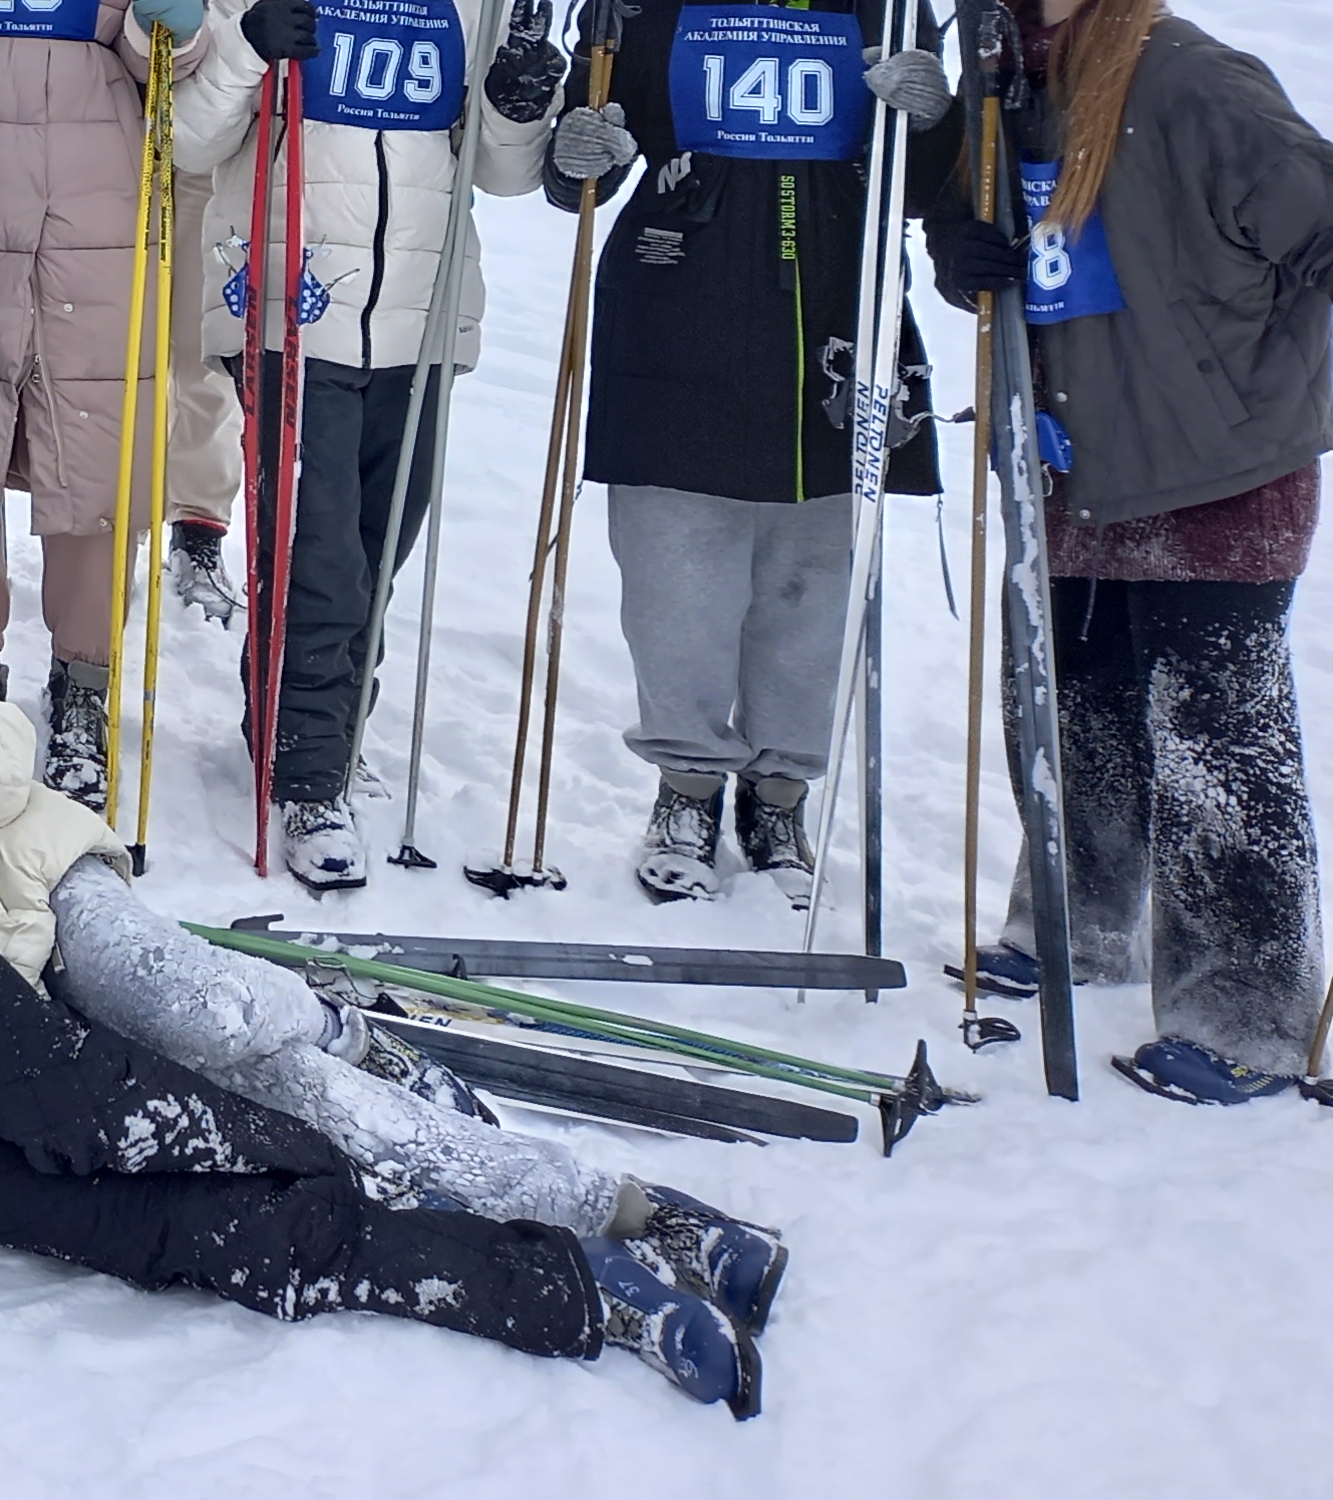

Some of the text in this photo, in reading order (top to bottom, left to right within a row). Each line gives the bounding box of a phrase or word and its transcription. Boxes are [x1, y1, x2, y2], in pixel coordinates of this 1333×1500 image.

[316, 6, 389, 24] АКАДЕМИЯ
[4, 20, 54, 32] Тольятти
[710, 17, 821, 33] ТОЛЬЯТТИНСКАЯ
[683, 30, 848, 46] АКАДЕМИЯ УПРАВЛЕНИЯ
[329, 32, 443, 104] 109
[703, 54, 834, 126] 140
[337, 103, 374, 117] Россия
[716, 129, 815, 144] Россия Тольятти
[863, 384, 889, 504] PELTONEN
